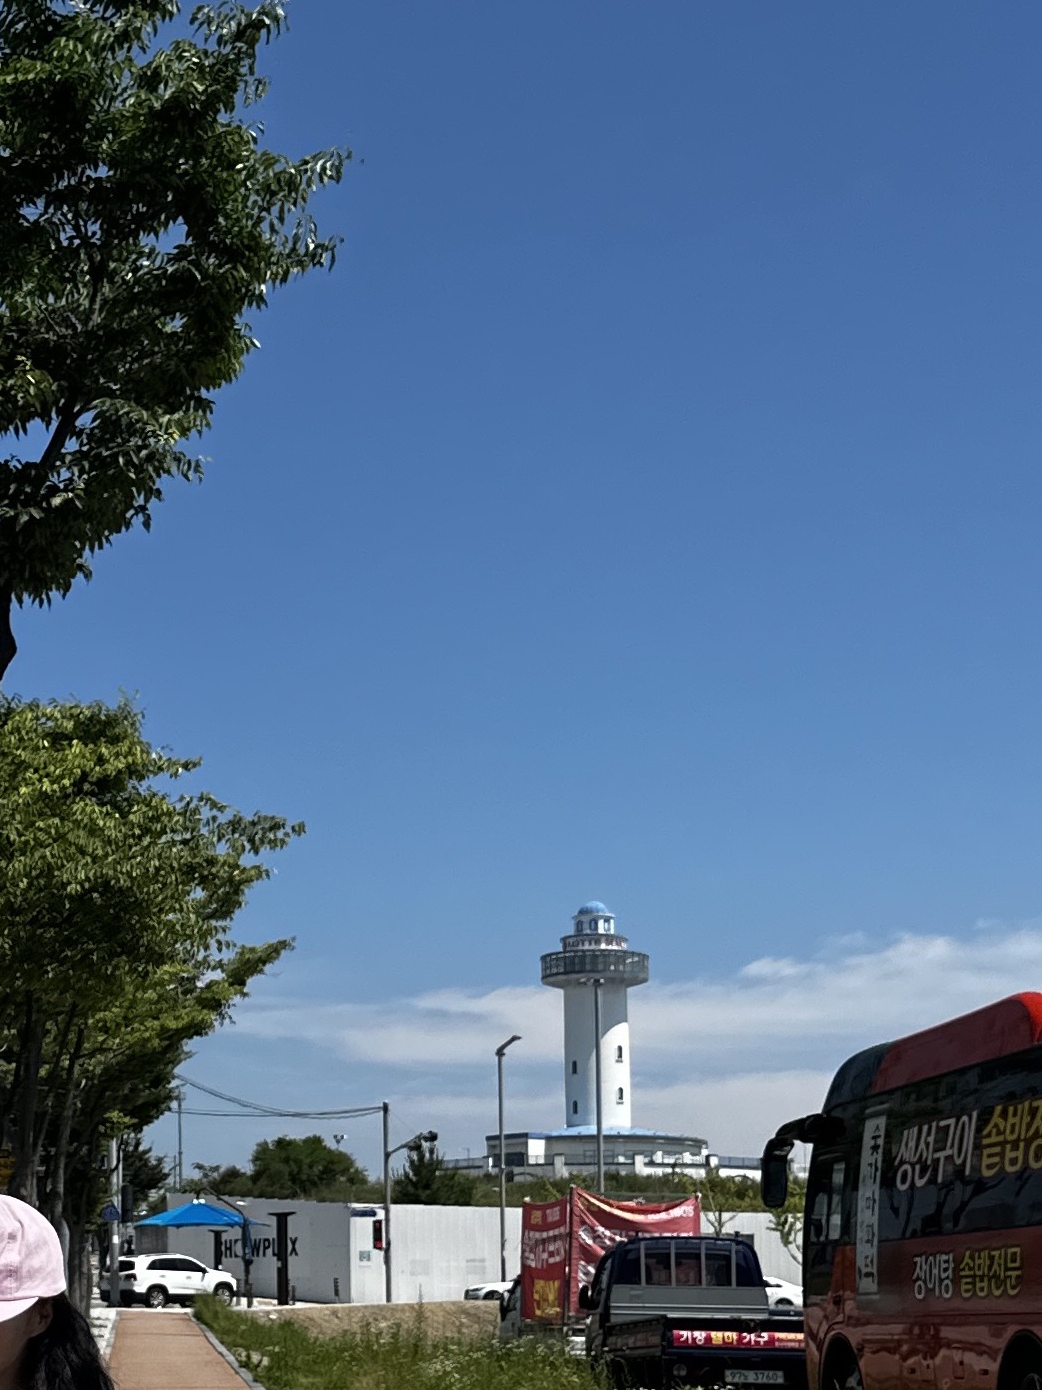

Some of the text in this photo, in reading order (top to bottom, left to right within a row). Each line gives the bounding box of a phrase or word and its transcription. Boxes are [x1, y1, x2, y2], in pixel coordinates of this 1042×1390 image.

[894, 1109, 979, 1192] 생선구이
[911, 1246, 1023, 1300] 장어탕 솥밥전문
